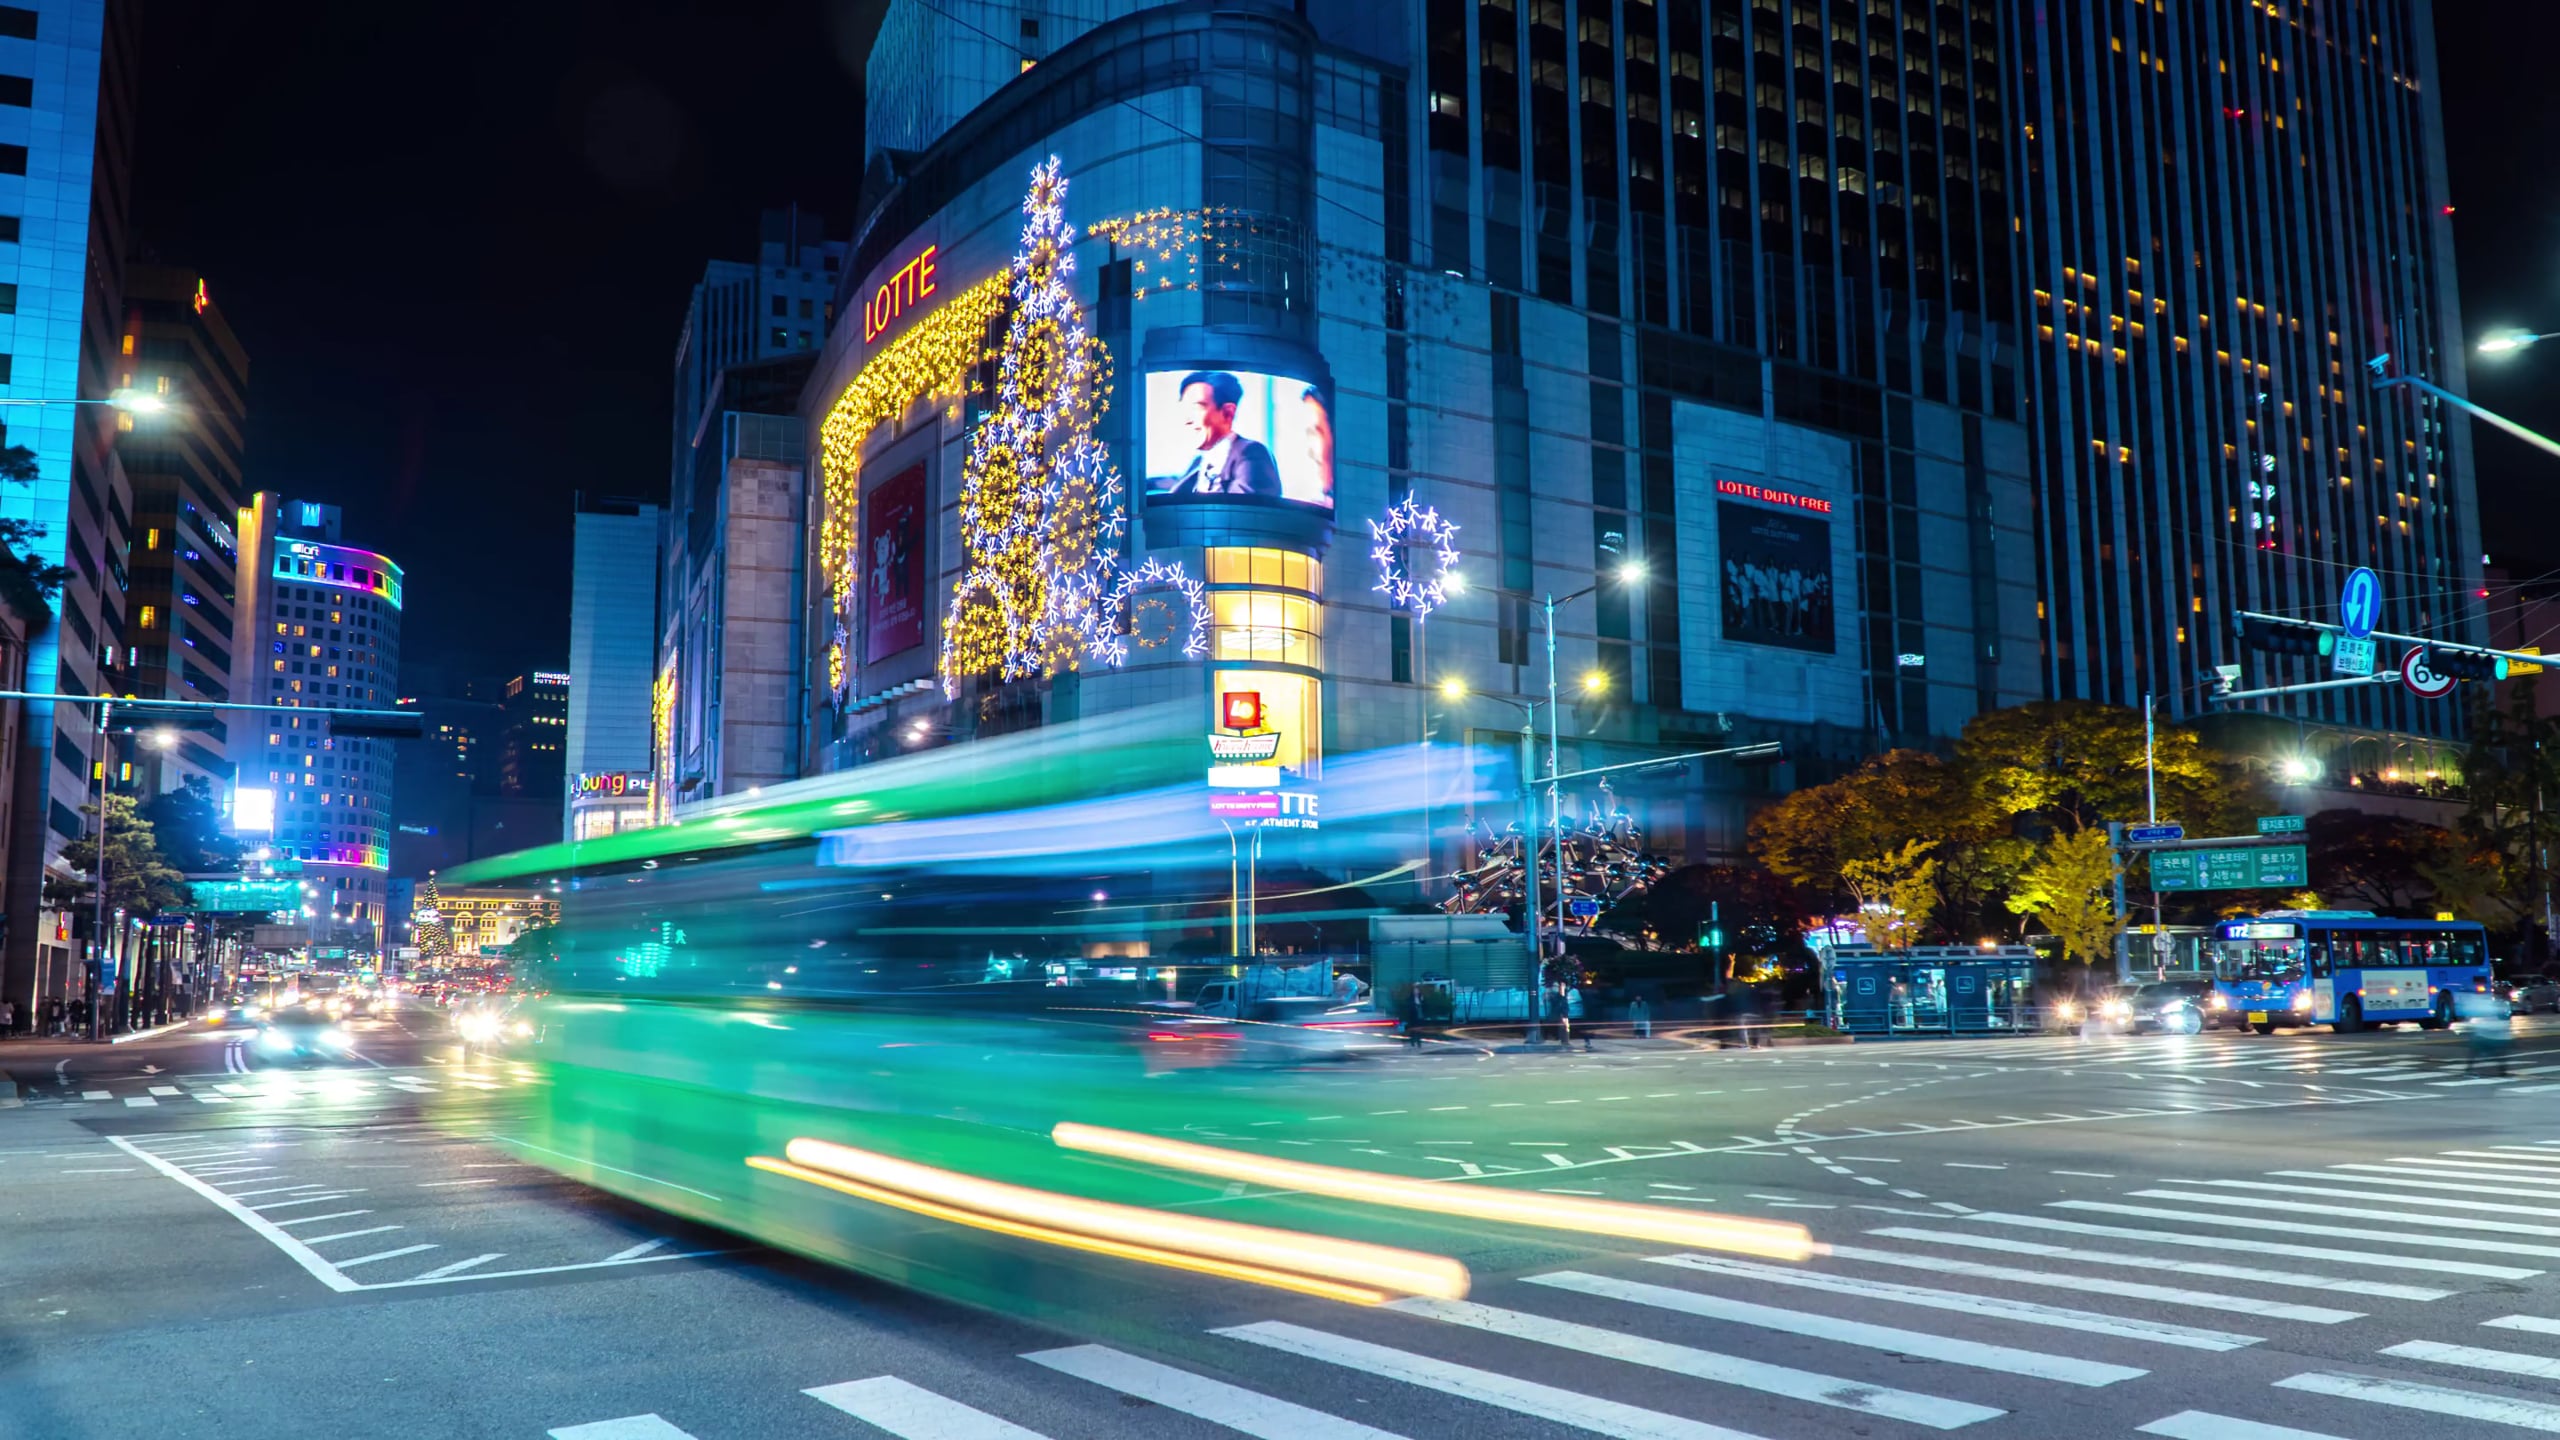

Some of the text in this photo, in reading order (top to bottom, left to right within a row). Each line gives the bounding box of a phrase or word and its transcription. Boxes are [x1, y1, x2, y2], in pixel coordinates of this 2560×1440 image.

[865, 245, 937, 343] LOTTE
[1717, 480, 1831, 512] LOTTE DUTY FREE
[575, 774, 626, 797] young
[629, 779, 650, 790] PL
[2262, 819, 2301, 830] 을지로1가
[2261, 853, 2296, 864] 종로1가
[2213, 870, 2229, 880] 시청
[2229, 924, 2249, 938] 172
